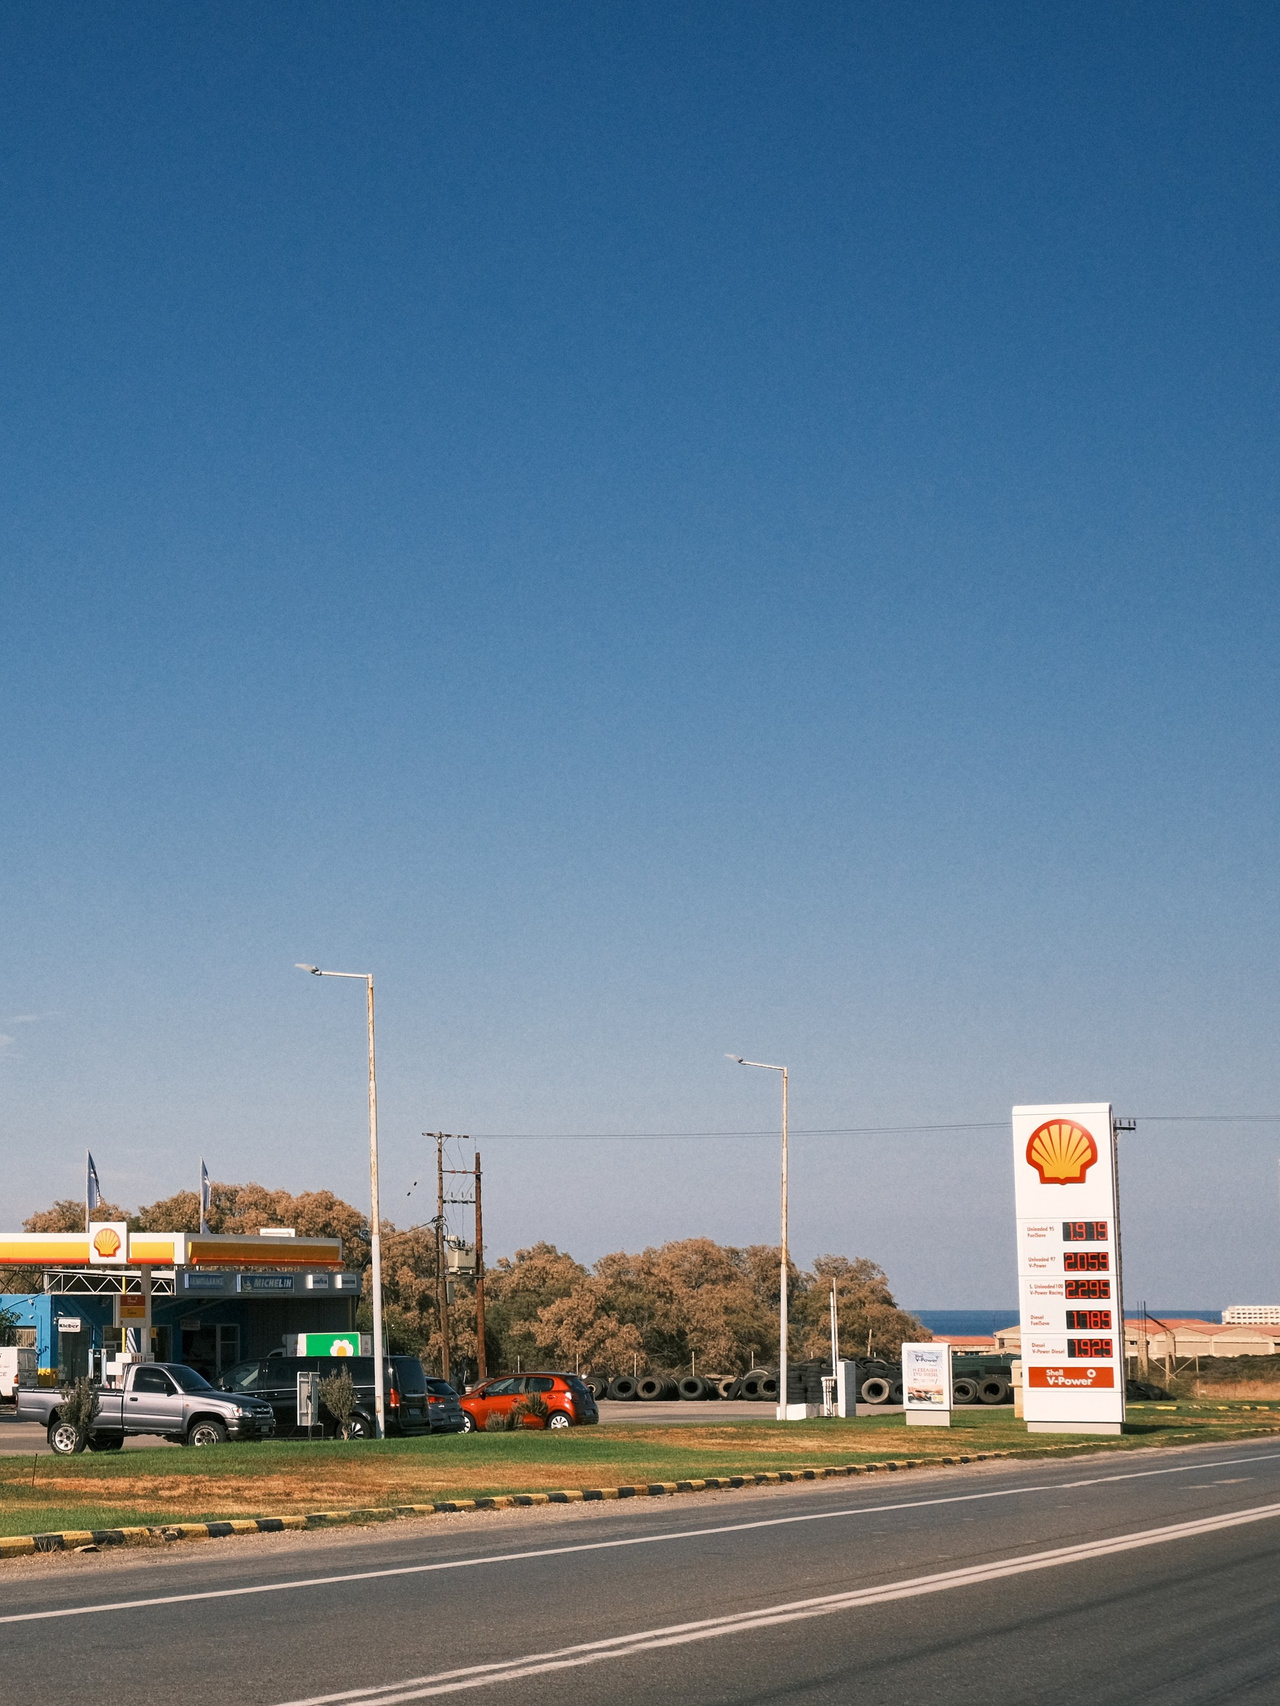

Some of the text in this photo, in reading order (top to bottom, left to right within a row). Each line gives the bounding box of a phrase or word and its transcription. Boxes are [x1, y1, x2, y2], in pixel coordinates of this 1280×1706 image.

[1069, 1222, 1108, 1240] 1.919
[1065, 1253, 1109, 1271] 2.059
[253, 1278, 292, 1288] MICHELIN
[1065, 1280, 1110, 1299] 2.295
[1073, 1311, 1111, 1329] 1.789
[1073, 1339, 1112, 1357] 1.929
[1045, 1368, 1064, 1376] Shell
[1046, 1376, 1093, 1386] V-Power
